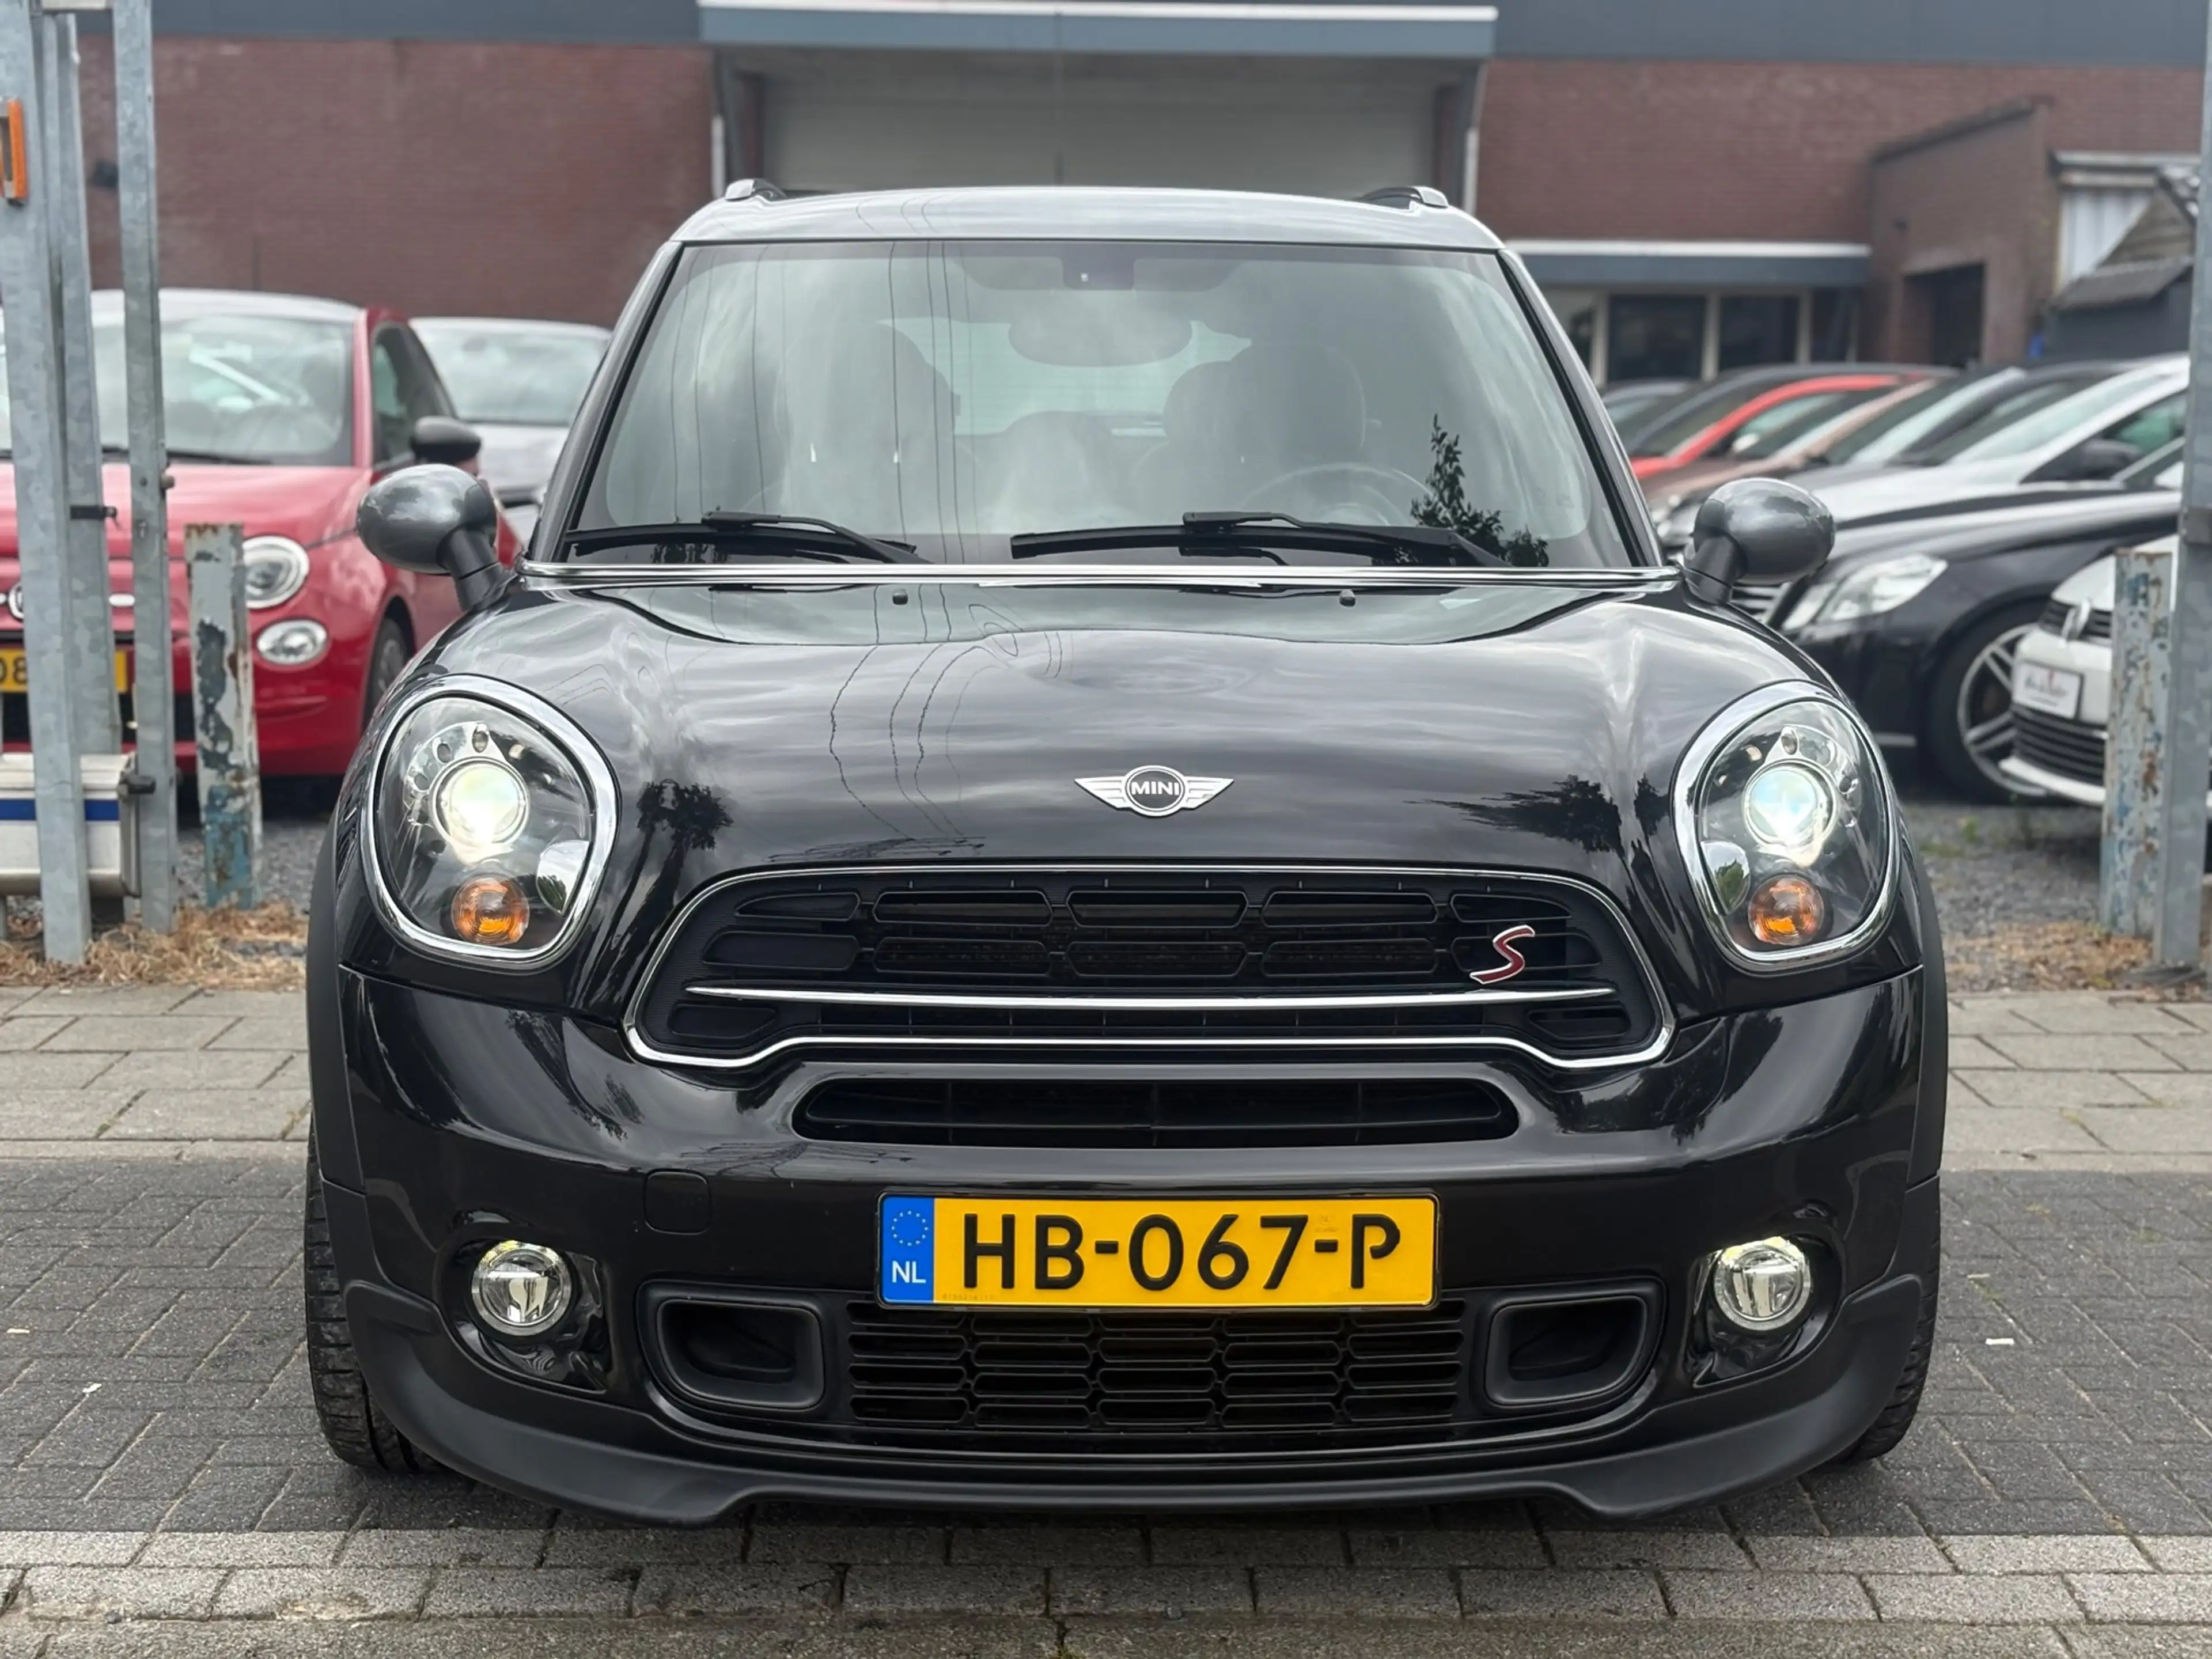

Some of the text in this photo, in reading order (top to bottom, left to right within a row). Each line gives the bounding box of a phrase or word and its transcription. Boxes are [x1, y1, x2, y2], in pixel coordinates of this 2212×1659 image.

[1131, 781, 1179, 796] MINI
[1469, 924, 1535, 984] S
[892, 1260, 927, 1283] NL
[963, 1213, 1401, 1291] HB-067-P
